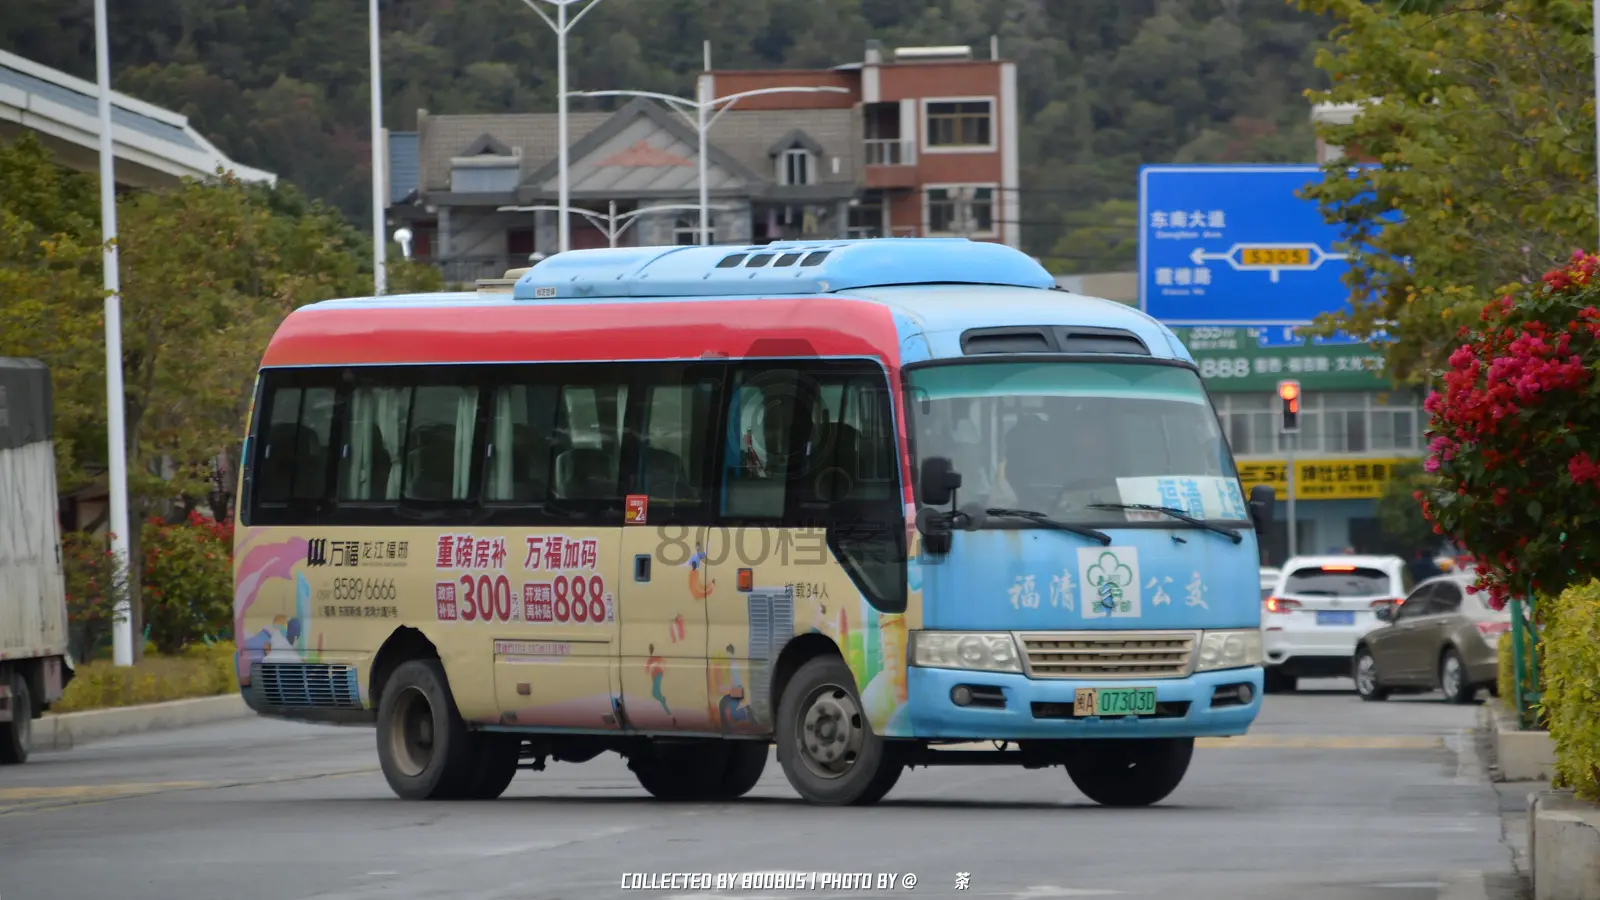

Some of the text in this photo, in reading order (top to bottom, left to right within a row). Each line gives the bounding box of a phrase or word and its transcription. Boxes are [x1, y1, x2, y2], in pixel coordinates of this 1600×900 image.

[330, 541, 360, 567] 万福
[436, 536, 597, 570] 重磅房补 万福加码
[333, 578, 363, 600] 8589
[366, 578, 396, 600] 6666
[460, 574, 511, 622] 300
[554, 575, 606, 623] 888
[1008, 568, 1209, 612] 福清 公交
